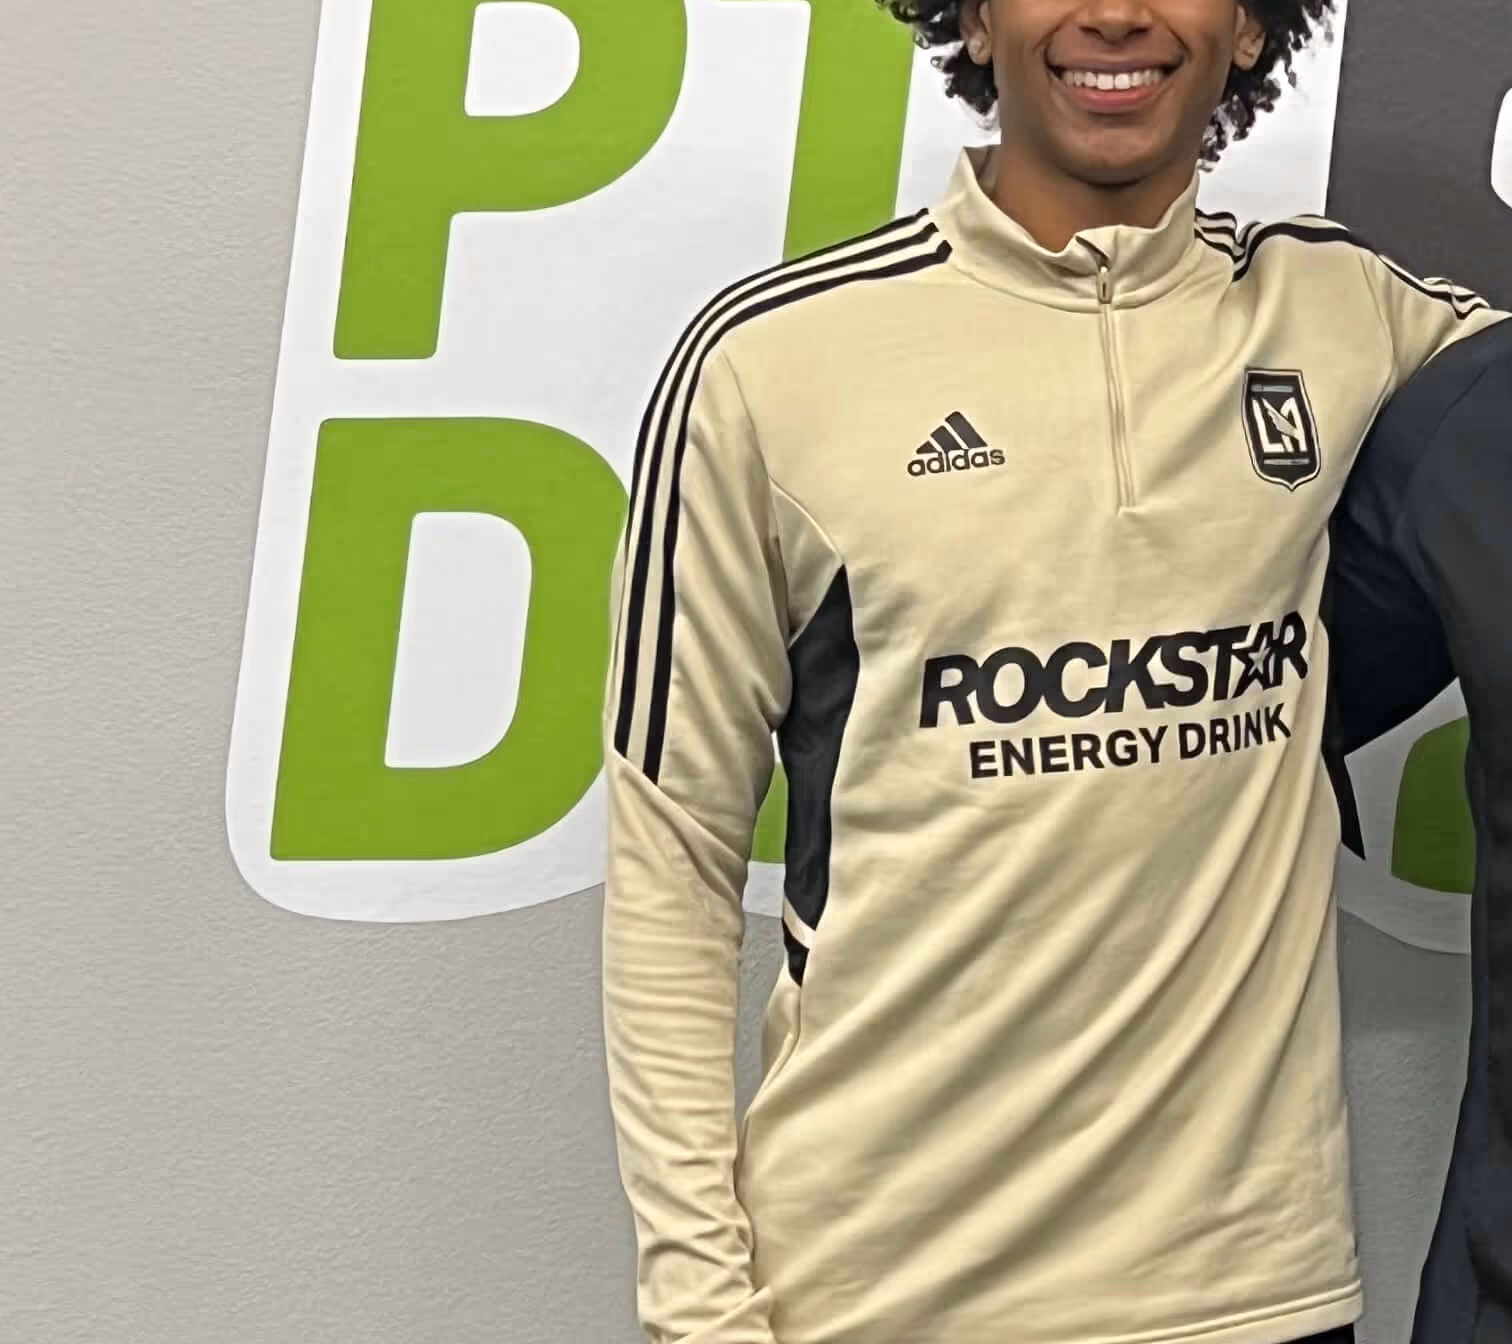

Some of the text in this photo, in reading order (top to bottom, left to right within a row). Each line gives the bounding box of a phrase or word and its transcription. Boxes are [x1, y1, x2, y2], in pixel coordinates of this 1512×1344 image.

[907, 448, 1006, 477] adidas
[919, 610, 1309, 728] ROCKSTAR
[969, 702, 1292, 779] ENERGY DRINK
